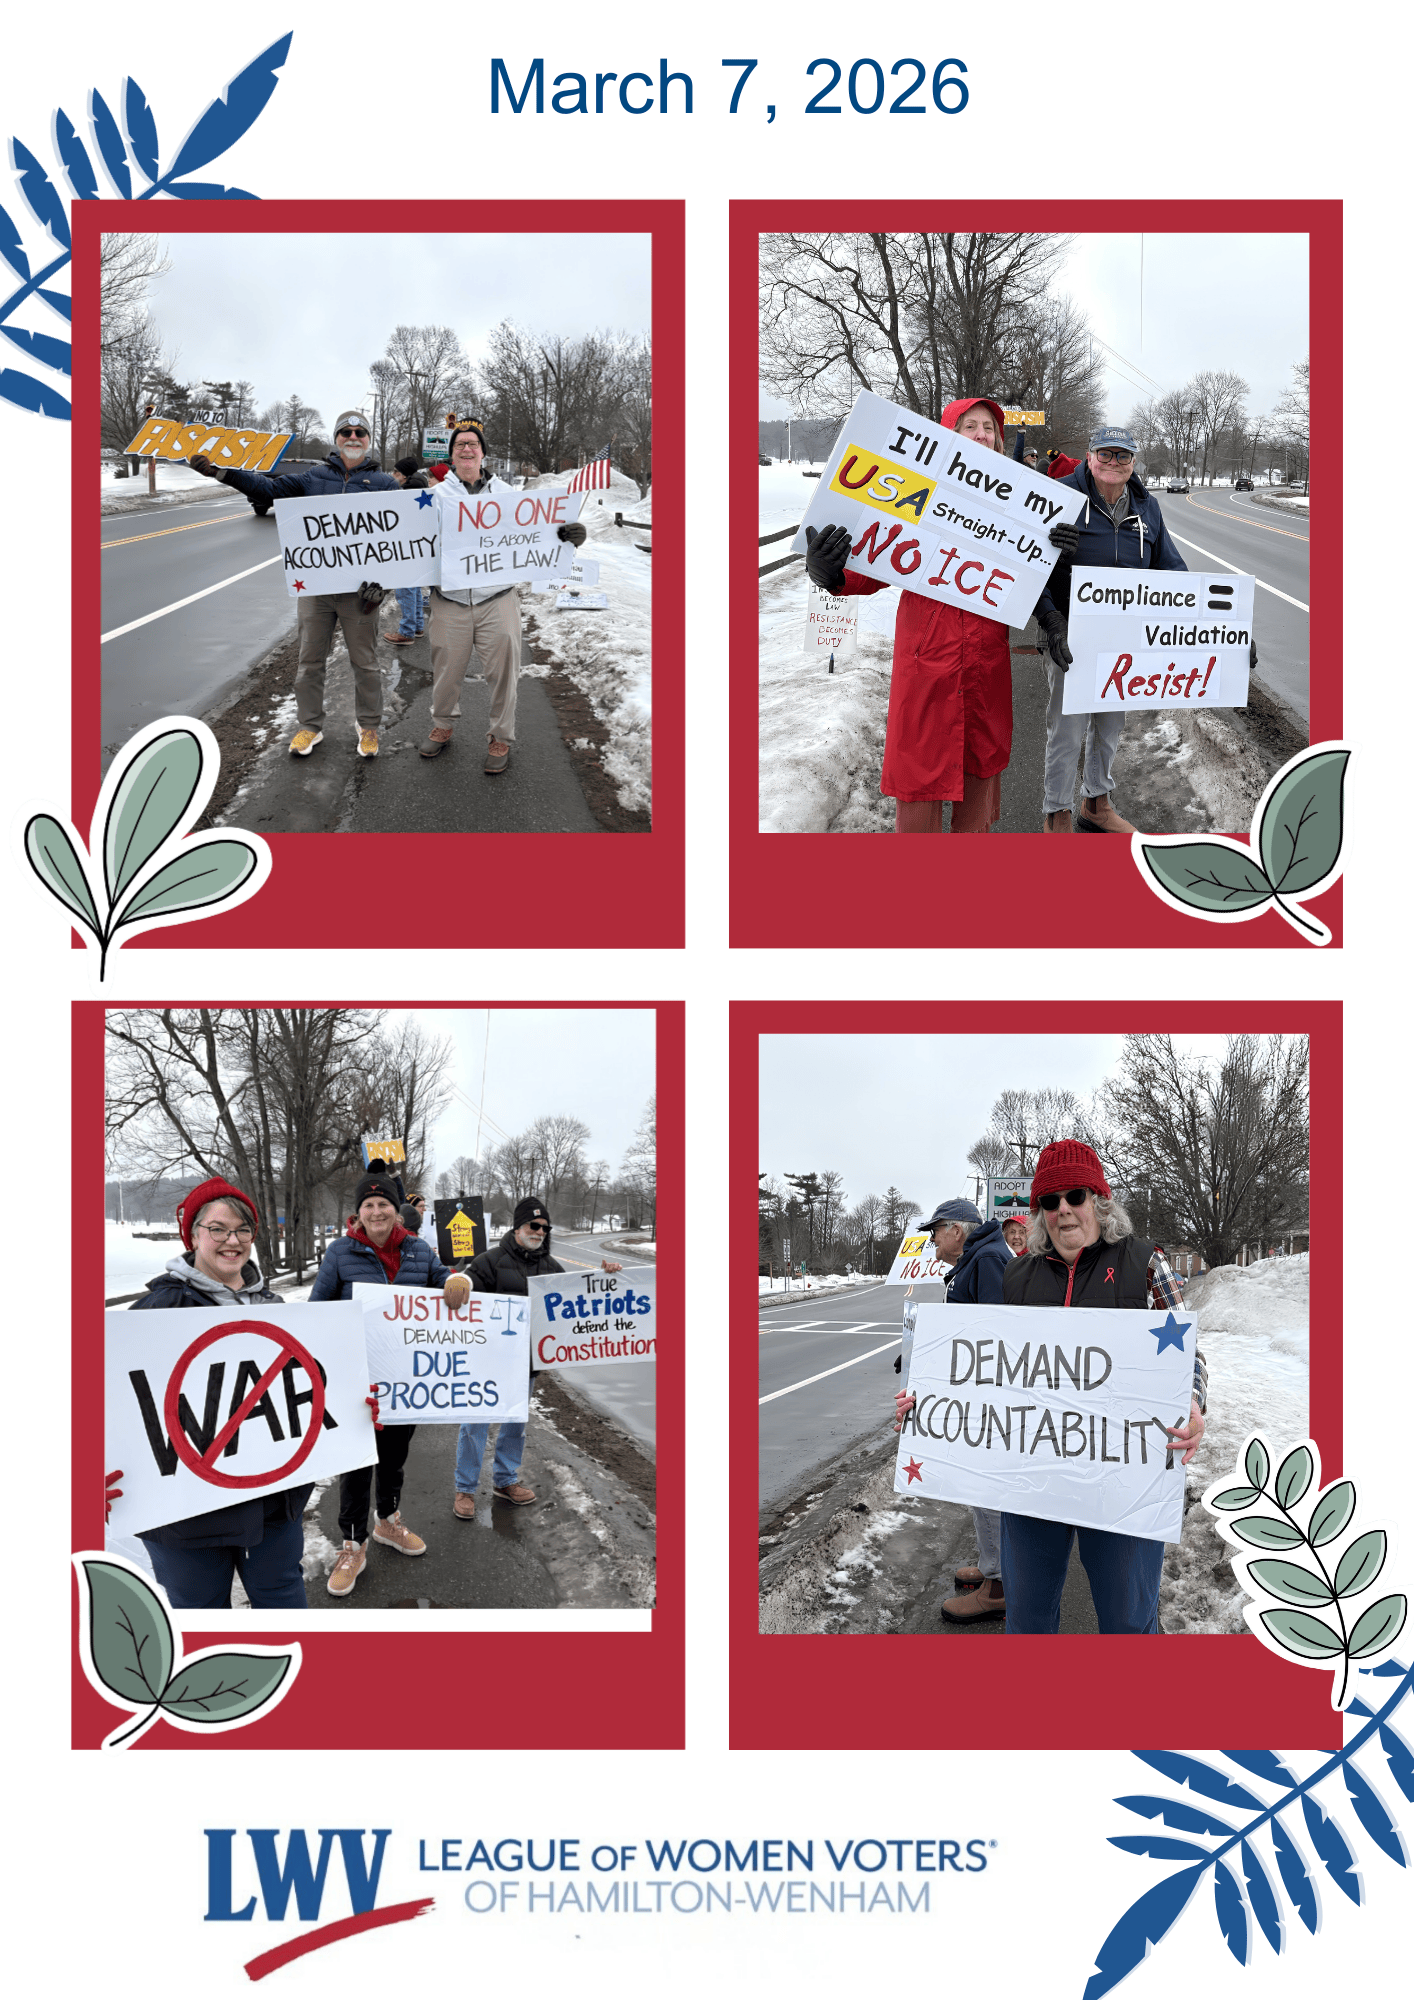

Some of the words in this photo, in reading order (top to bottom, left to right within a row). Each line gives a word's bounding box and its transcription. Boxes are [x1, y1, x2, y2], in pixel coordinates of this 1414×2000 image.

[211, 411, 225, 424] TO
[123, 418, 293, 472] FASCISM
[888, 425, 939, 466] I'll
[947, 451, 1013, 500] have
[1024, 490, 1064, 524] my
[458, 500, 502, 532] NO
[515, 495, 569, 526] ONE
[838, 454, 930, 517] USA
[932, 502, 1052, 566] Straight-Up...
[302, 509, 399, 541] DEMAND
[479, 536, 494, 548] IS
[497, 531, 542, 547] ABOVE
[284, 534, 438, 570] ACCOUNTABILITY
[460, 552, 504, 575] THE
[512, 545, 562, 569] LAW!
[851, 520, 922, 576] NO
[927, 547, 1016, 607] ICE
[819, 595, 848, 603] BECOMES
[825, 602, 840, 611] LAW
[1077, 581, 1196, 610] Compliance
[809, 612, 857, 626] RESISTANCE
[818, 625, 854, 635] BECOMES
[817, 636, 843, 647] DUTY
[1145, 624, 1249, 646] Validation
[1100, 653, 1217, 700] Resist!
[994, 1180, 1026, 1191] ADOPT
[900, 1239, 927, 1254] USA
[899, 1258, 921, 1279] NO
[581, 1273, 618, 1294] True
[382, 1294, 483, 1323] JUSTICE
[543, 1289, 651, 1322] Patriots
[403, 1327, 487, 1345] DEMANDS
[572, 1319, 609, 1334] defend
[614, 1317, 637, 1331] the
[537, 1334, 657, 1364] Constitution
[413, 1350, 471, 1378] DUE
[949, 1338, 1112, 1391] DEMAND
[373, 1380, 499, 1410] PROCESS
[128, 1356, 339, 1477] WAR
[900, 1389, 1185, 1471] ACCOUNTABILITY
